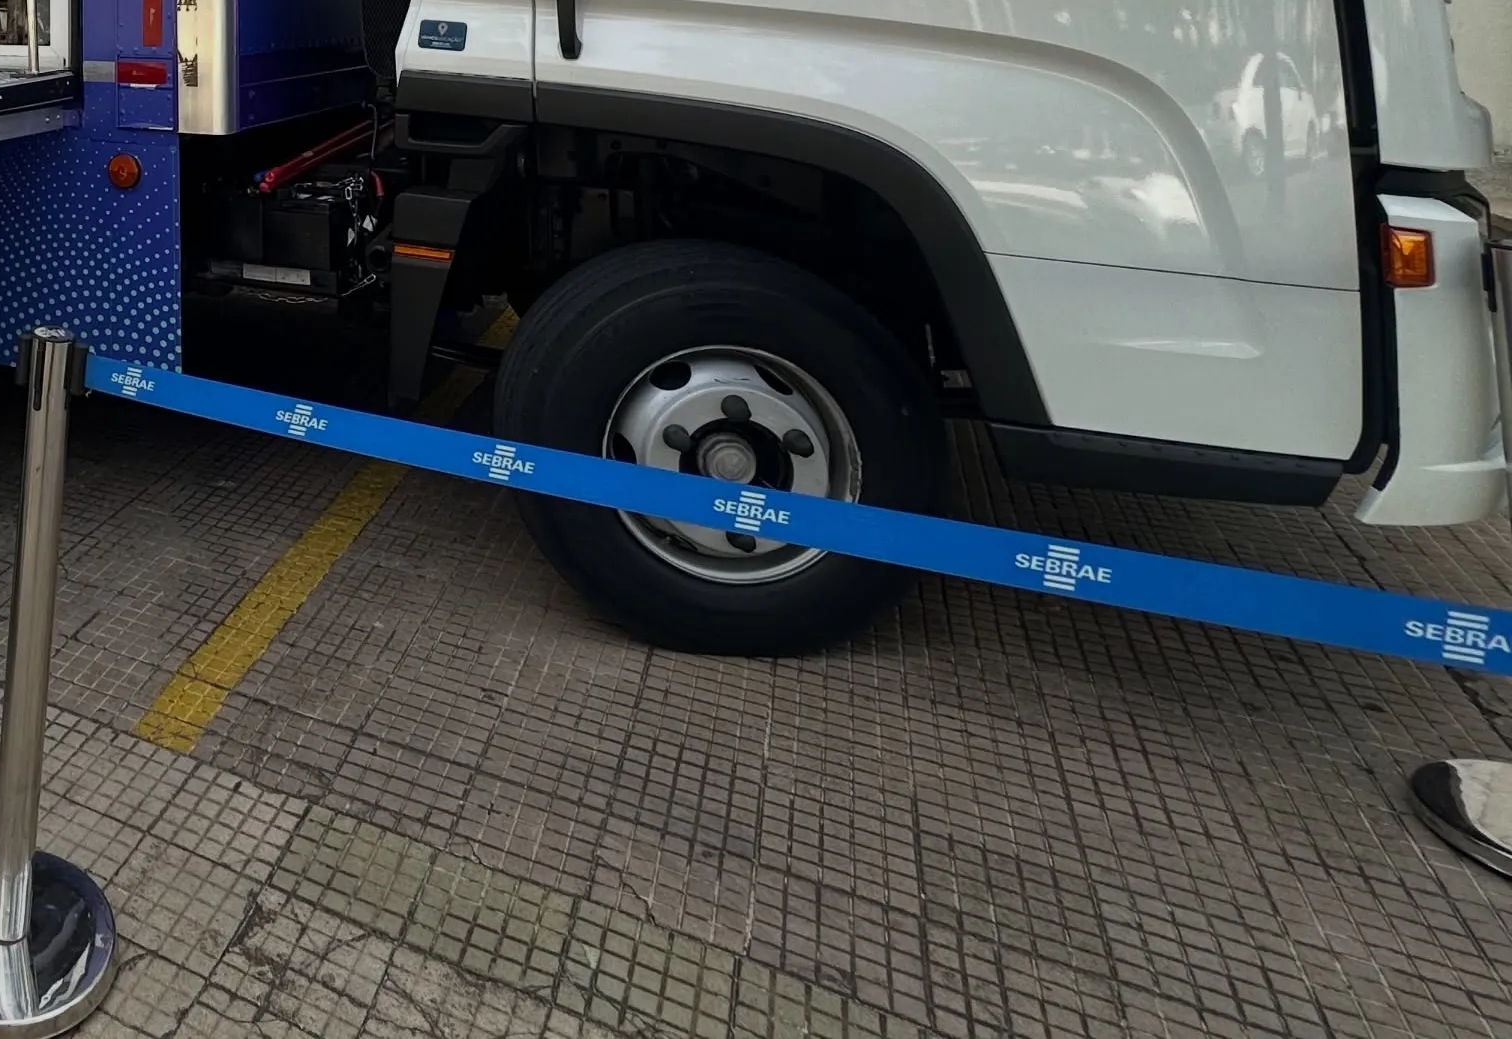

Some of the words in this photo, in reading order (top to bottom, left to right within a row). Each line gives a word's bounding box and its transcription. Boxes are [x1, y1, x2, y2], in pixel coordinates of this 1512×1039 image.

[111, 372, 155, 391] SEBRAE
[275, 410, 328, 431] SEBRAE
[472, 451, 535, 474] SEBRAE
[713, 498, 791, 525] SEBRAE
[1014, 553, 1113, 584] SEBRAE
[1403, 620, 1512, 654] SEBRA
